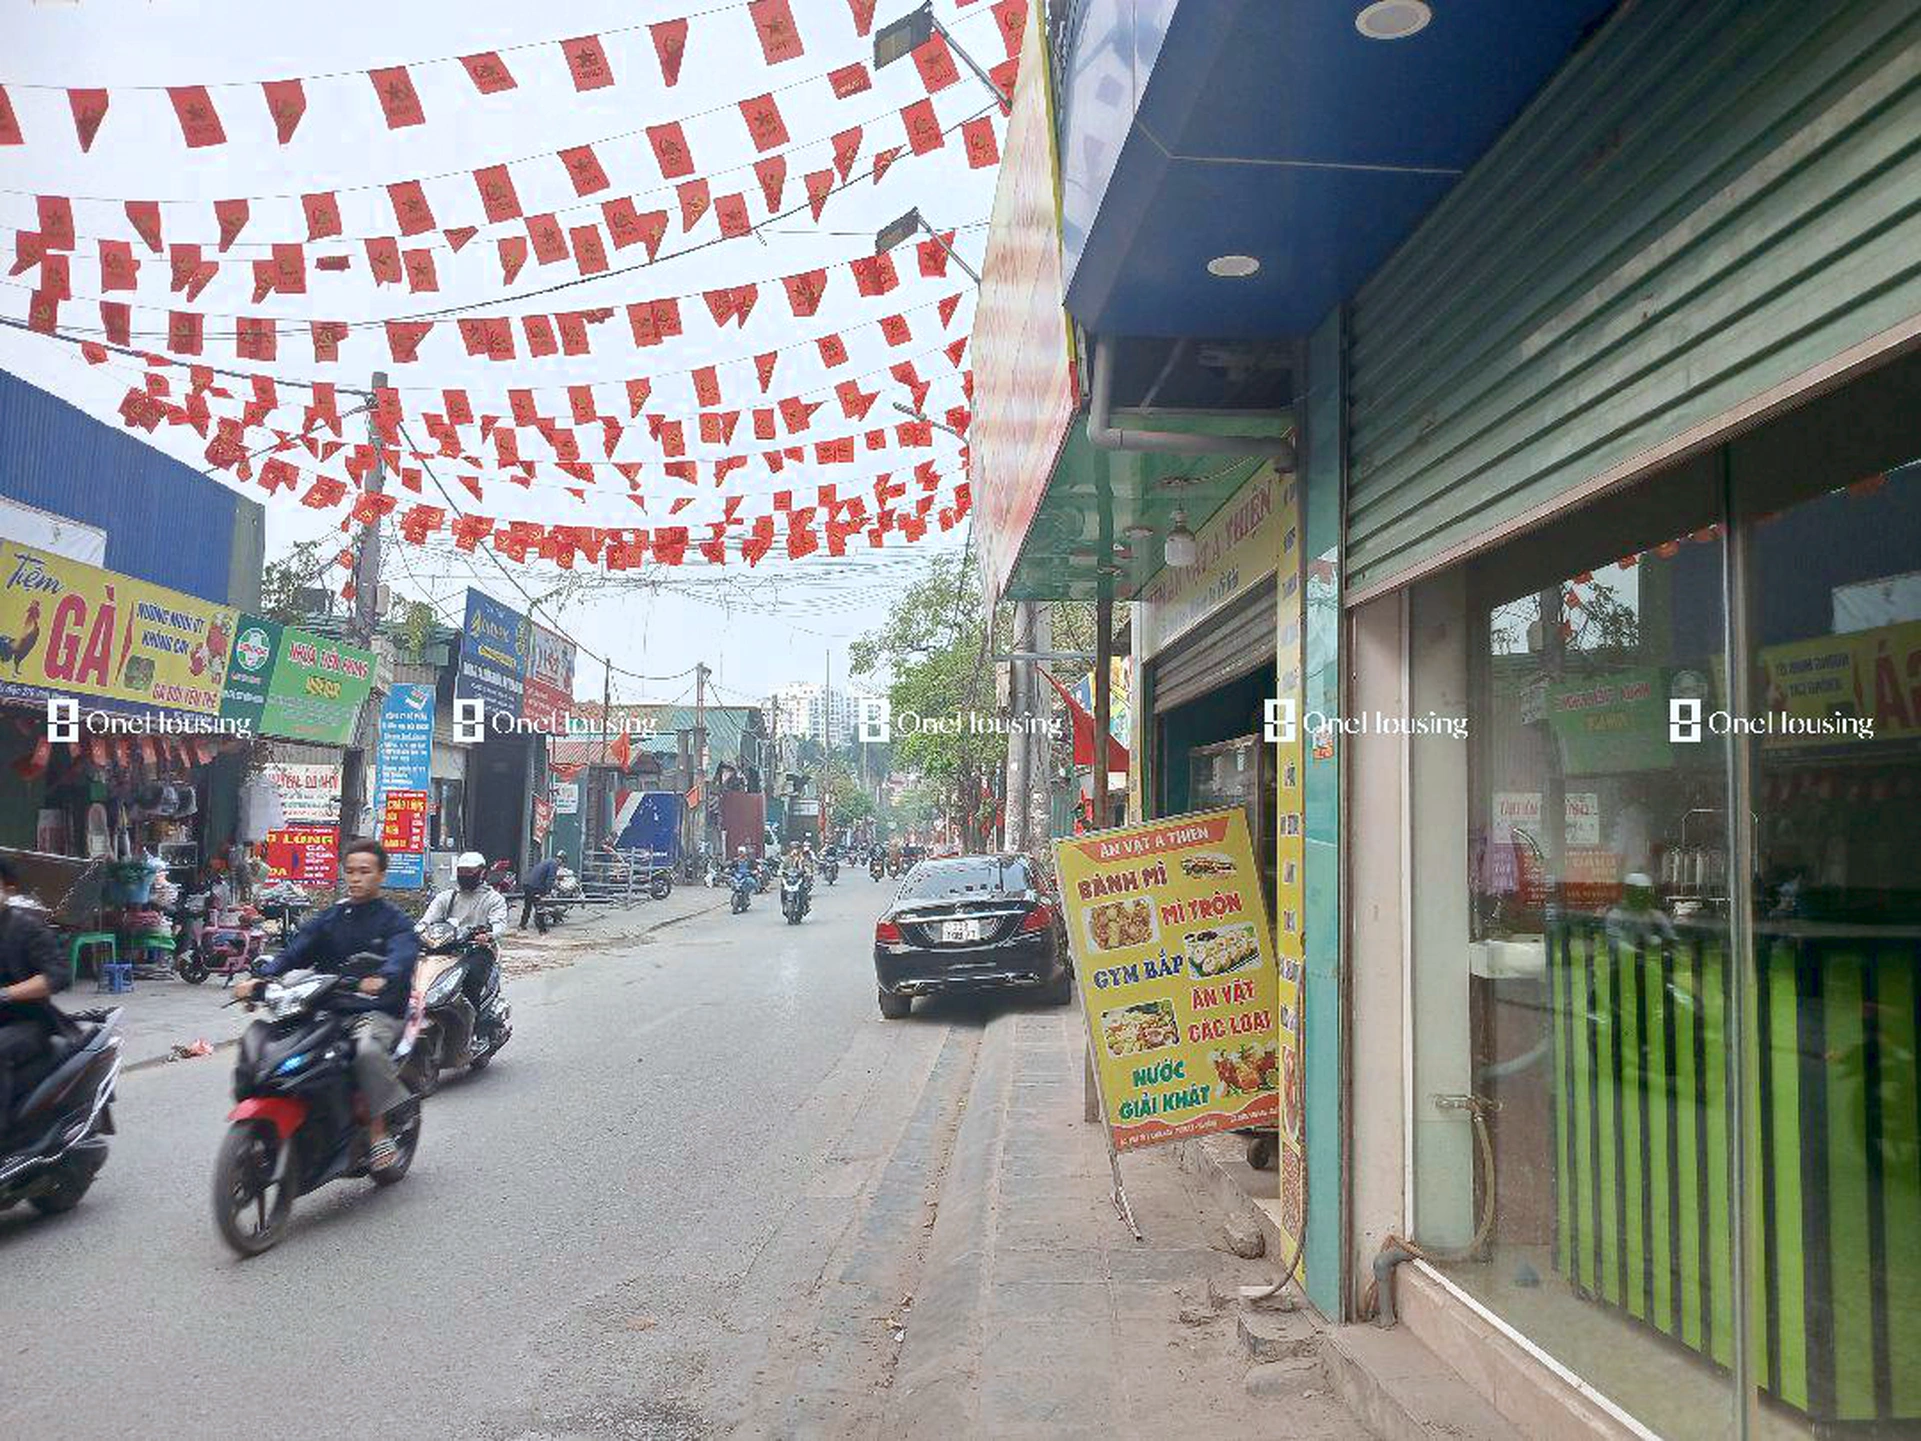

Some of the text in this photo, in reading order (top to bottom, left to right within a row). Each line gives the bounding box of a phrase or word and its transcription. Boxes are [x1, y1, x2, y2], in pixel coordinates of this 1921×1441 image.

[44, 582, 116, 687] GÀ
[1155, 834, 1166, 848] A
[1093, 964, 1140, 989] GYM
